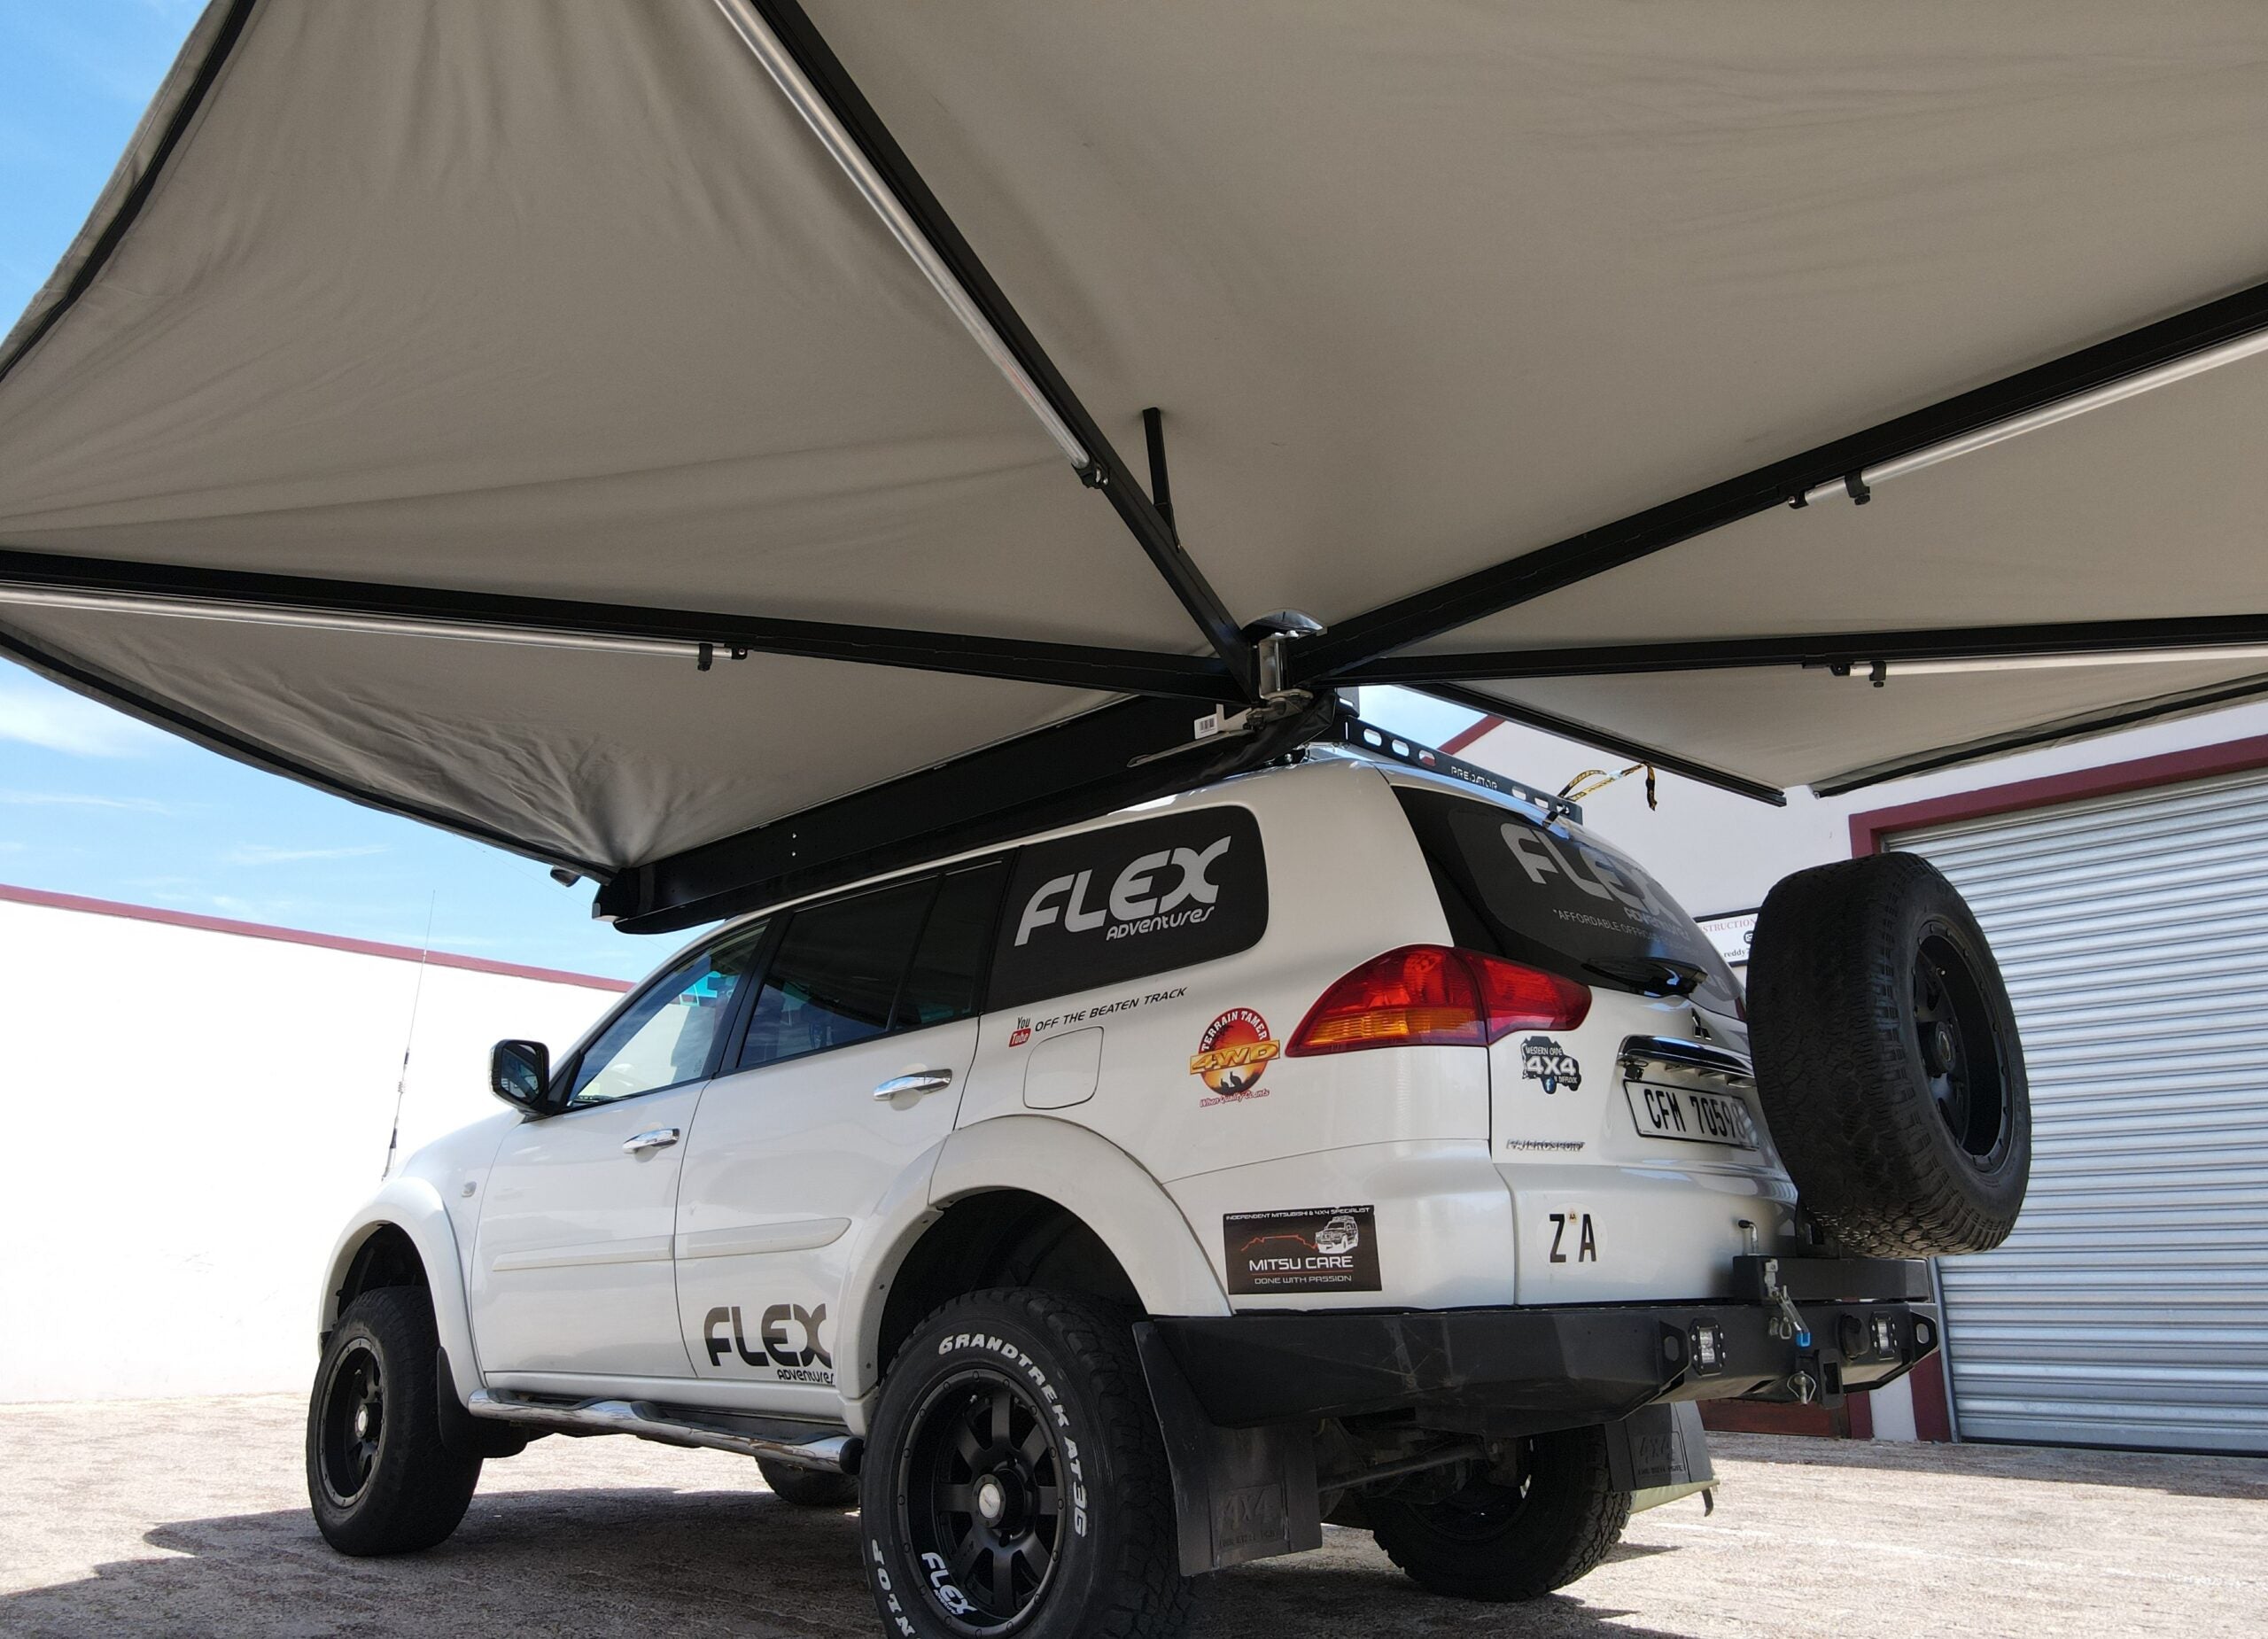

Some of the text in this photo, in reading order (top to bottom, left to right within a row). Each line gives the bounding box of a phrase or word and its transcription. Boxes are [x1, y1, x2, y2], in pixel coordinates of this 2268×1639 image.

[1450, 765, 1498, 790] PREDATOR
[1500, 822, 1683, 928] FLEX
[1014, 835, 1231, 947] FLEX
[1700, 917, 1757, 933] STRUCTION
[1016, 1017, 1030, 1029] You
[1035, 986, 1188, 1032] OFF THE BEATEN TRACK
[1011, 1030, 1029, 1045] Tube
[1200, 1010, 1268, 1052] TERRAIN TAMER
[1192, 1043, 1279, 1071] 4WD
[1526, 1055, 1577, 1076] 4X4
[1643, 1089, 1686, 1132] CFM
[1270, 1210, 1309, 1219] MITSUBISHI
[1249, 1255, 1354, 1271] MITSU CARE
[1254, 1277, 1281, 1286] DONE
[1309, 1274, 1352, 1283] PASSION
[703, 1302, 833, 1370] FLEX
[937, 1332, 1070, 1428] GRANDTREK
[921, 1551, 978, 1615] FLEX
